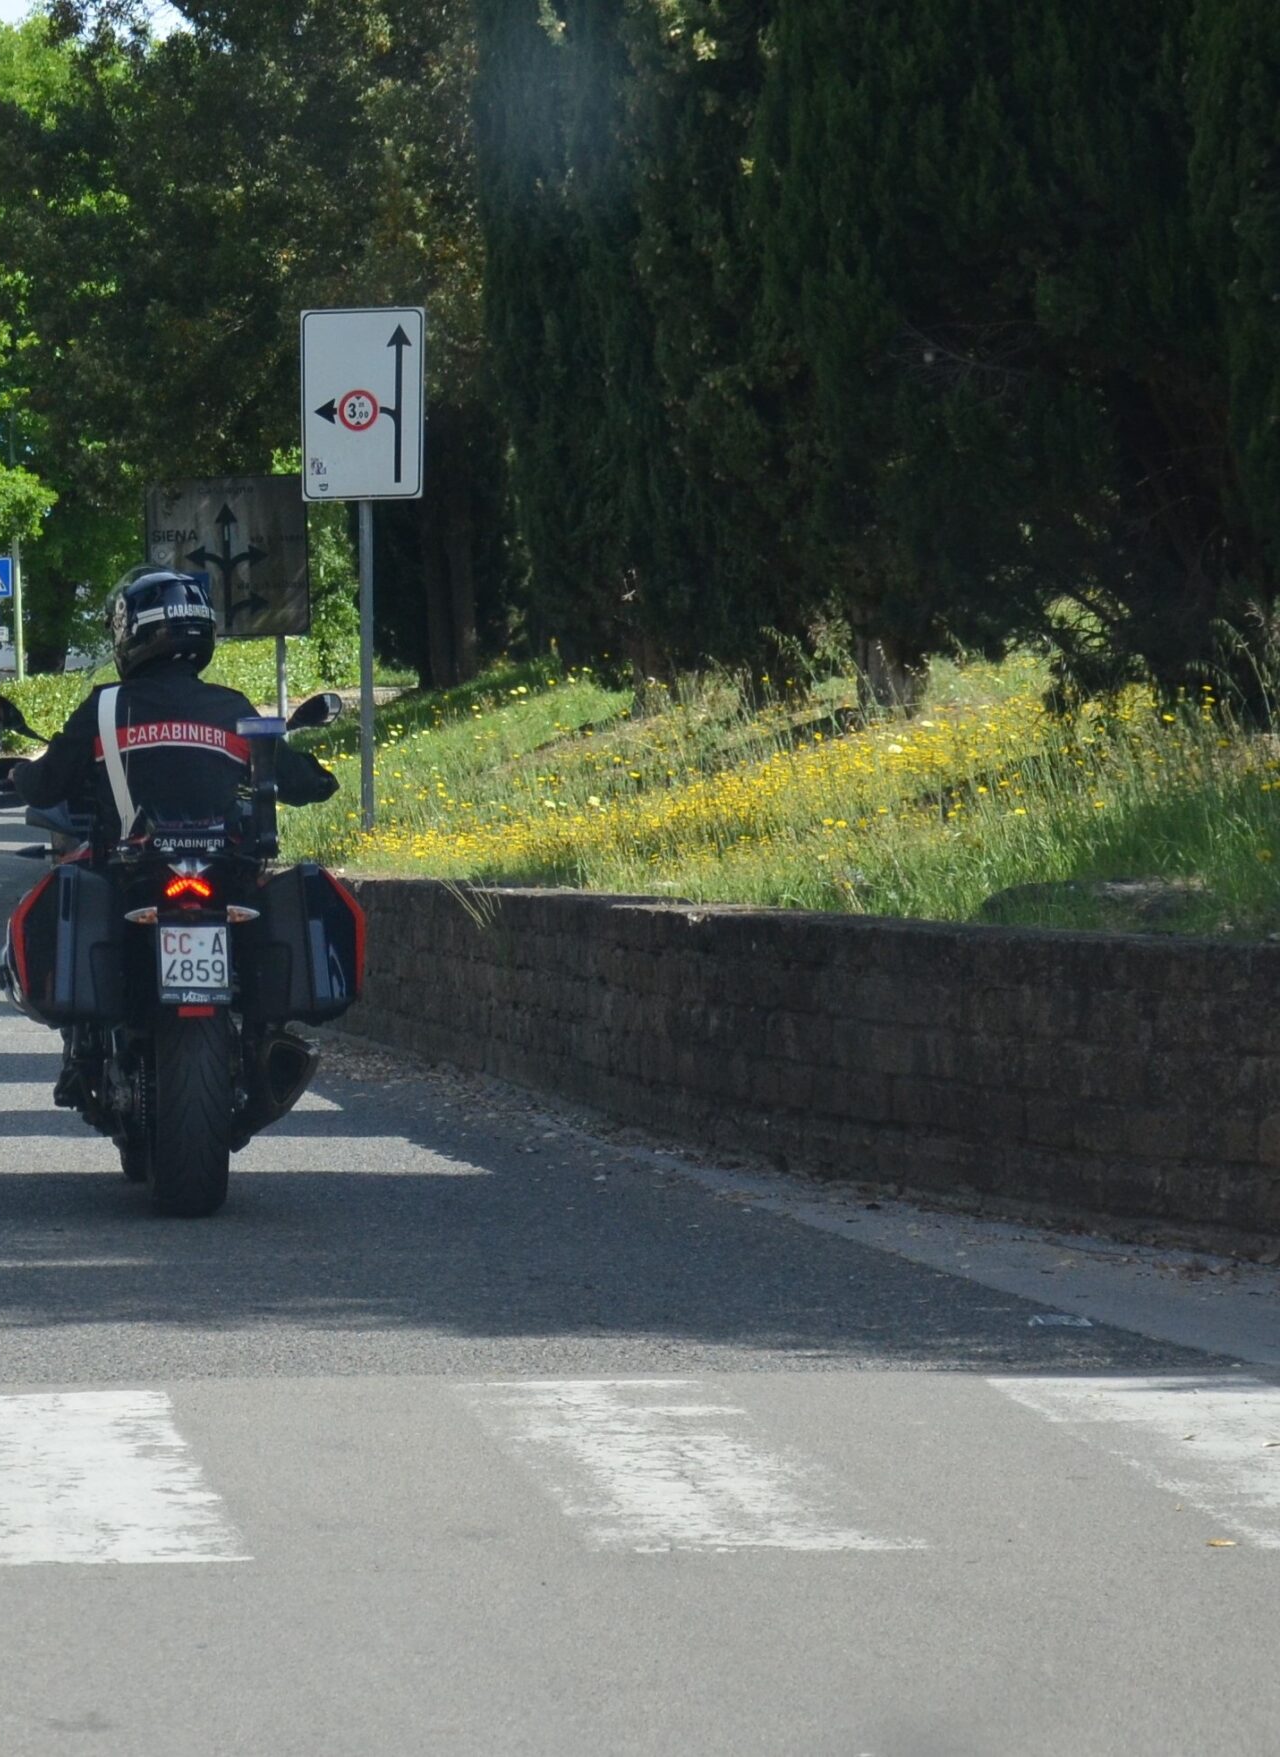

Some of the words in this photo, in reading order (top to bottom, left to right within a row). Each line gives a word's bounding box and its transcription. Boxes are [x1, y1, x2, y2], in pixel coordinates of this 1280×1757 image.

[152, 529, 198, 543] SIENA
[128, 723, 226, 747] CARABINIERI
[153, 838, 225, 848] CARABINIERI
[163, 932, 192, 955] CC
[211, 932, 224, 955] A
[166, 959, 225, 983] 4859
